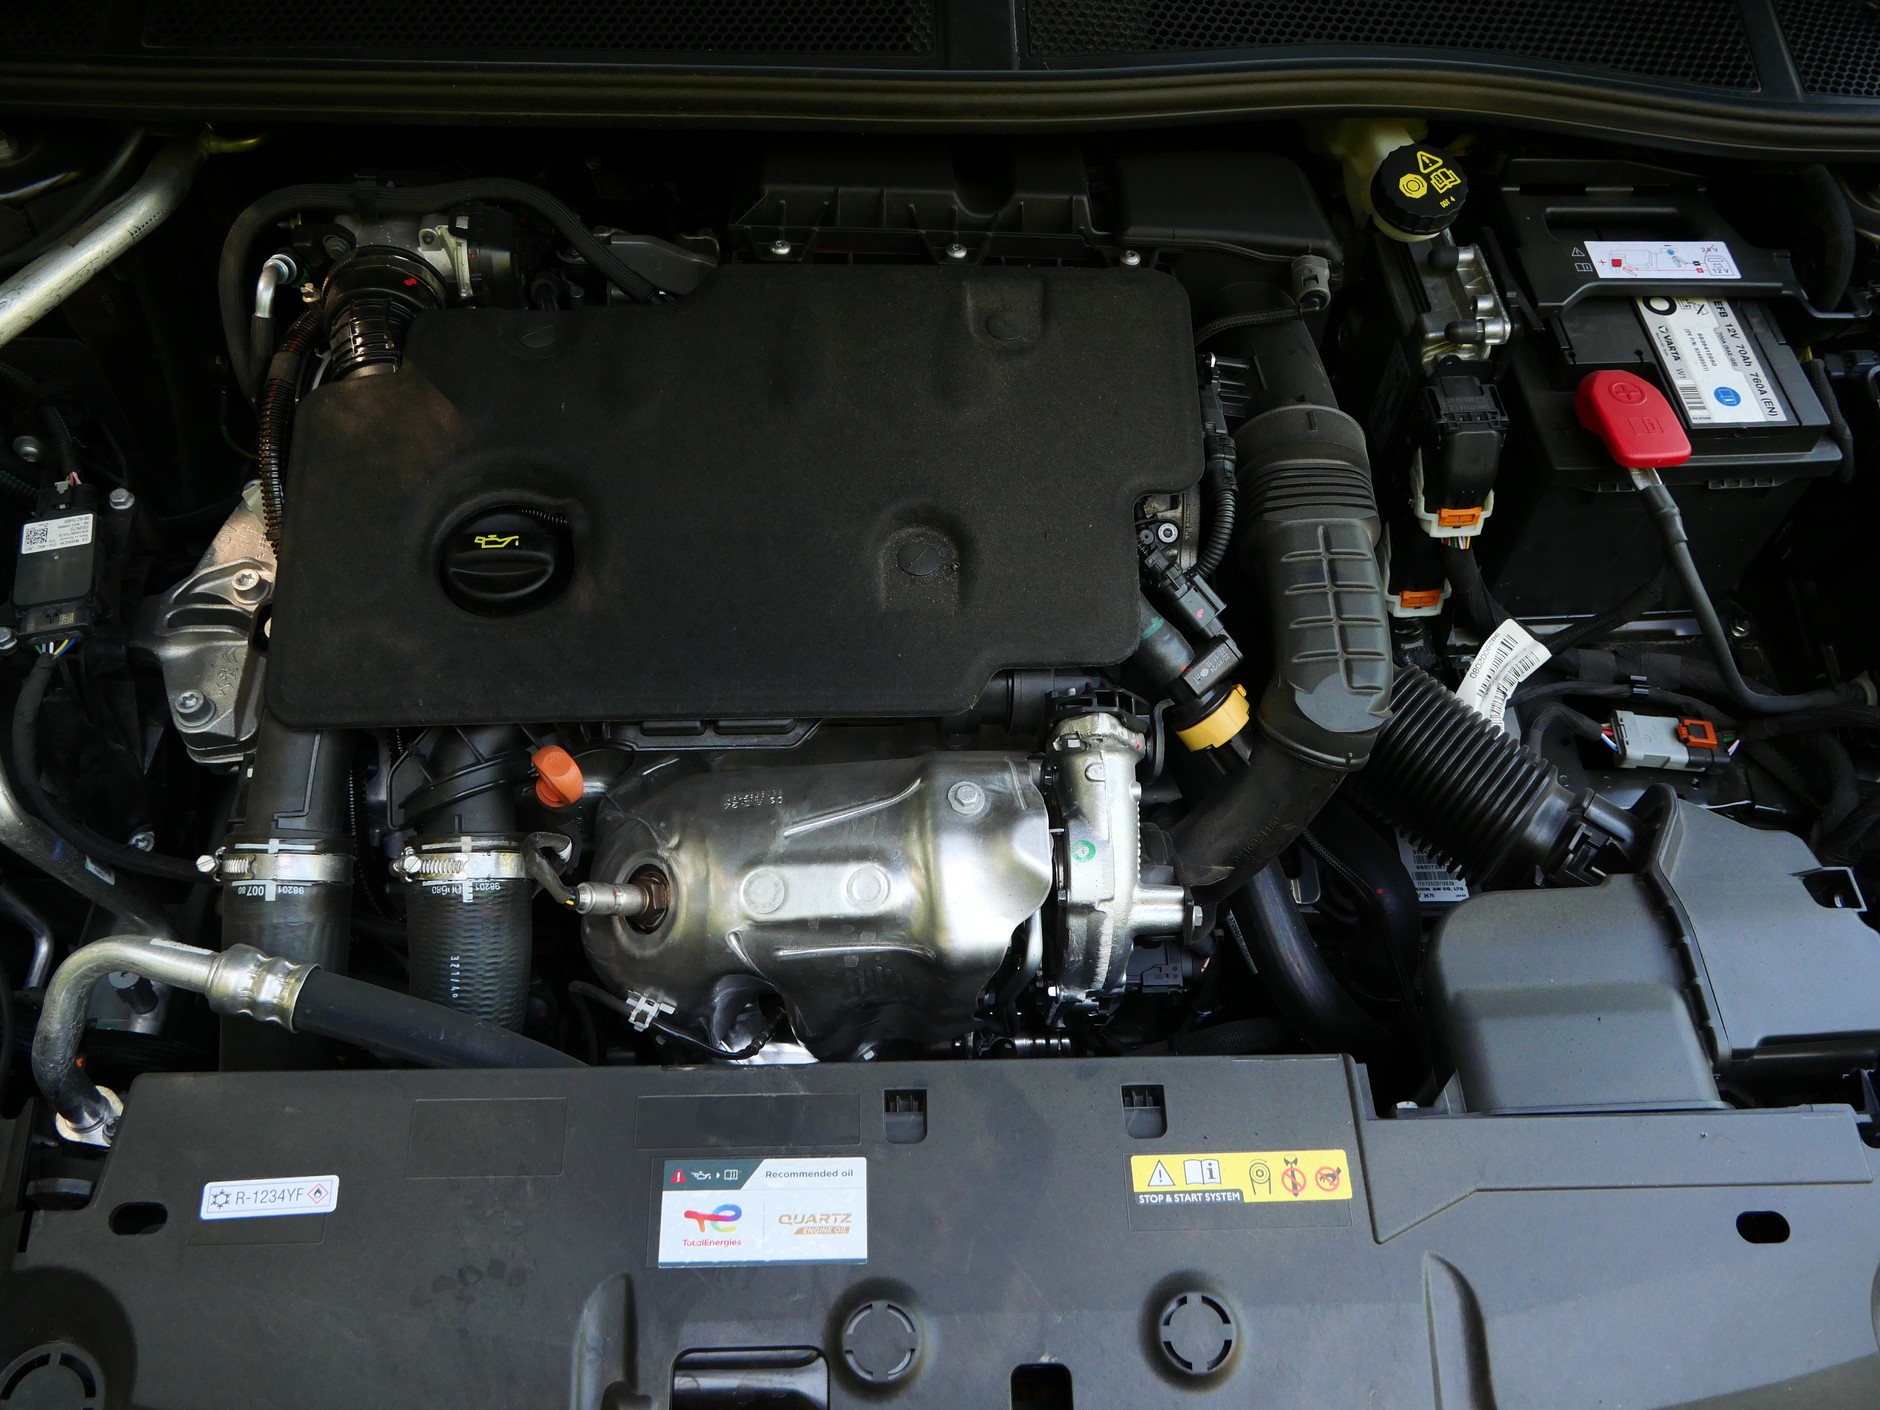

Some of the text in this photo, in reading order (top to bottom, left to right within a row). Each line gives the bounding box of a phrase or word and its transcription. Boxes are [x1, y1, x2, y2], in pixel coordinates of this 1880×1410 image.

[1440, 199, 1450, 208] DOT
[1663, 334, 1687, 379] VARTA W1
[1713, 301, 1778, 417] EFB 12V 70Ah 760A (EN)
[278, 886, 305, 895] 98201
[475, 882, 500, 891] 98201
[765, 1169, 854, 1179] Recommended oil
[235, 1188, 304, 1205] R-1234YF
[1139, 1192, 1240, 1204] STOP & START SYSTEM
[778, 1213, 852, 1226] QUARTZ
[834, 1226, 848, 1234] OIL
[682, 1238, 742, 1248] TotalEnergies
